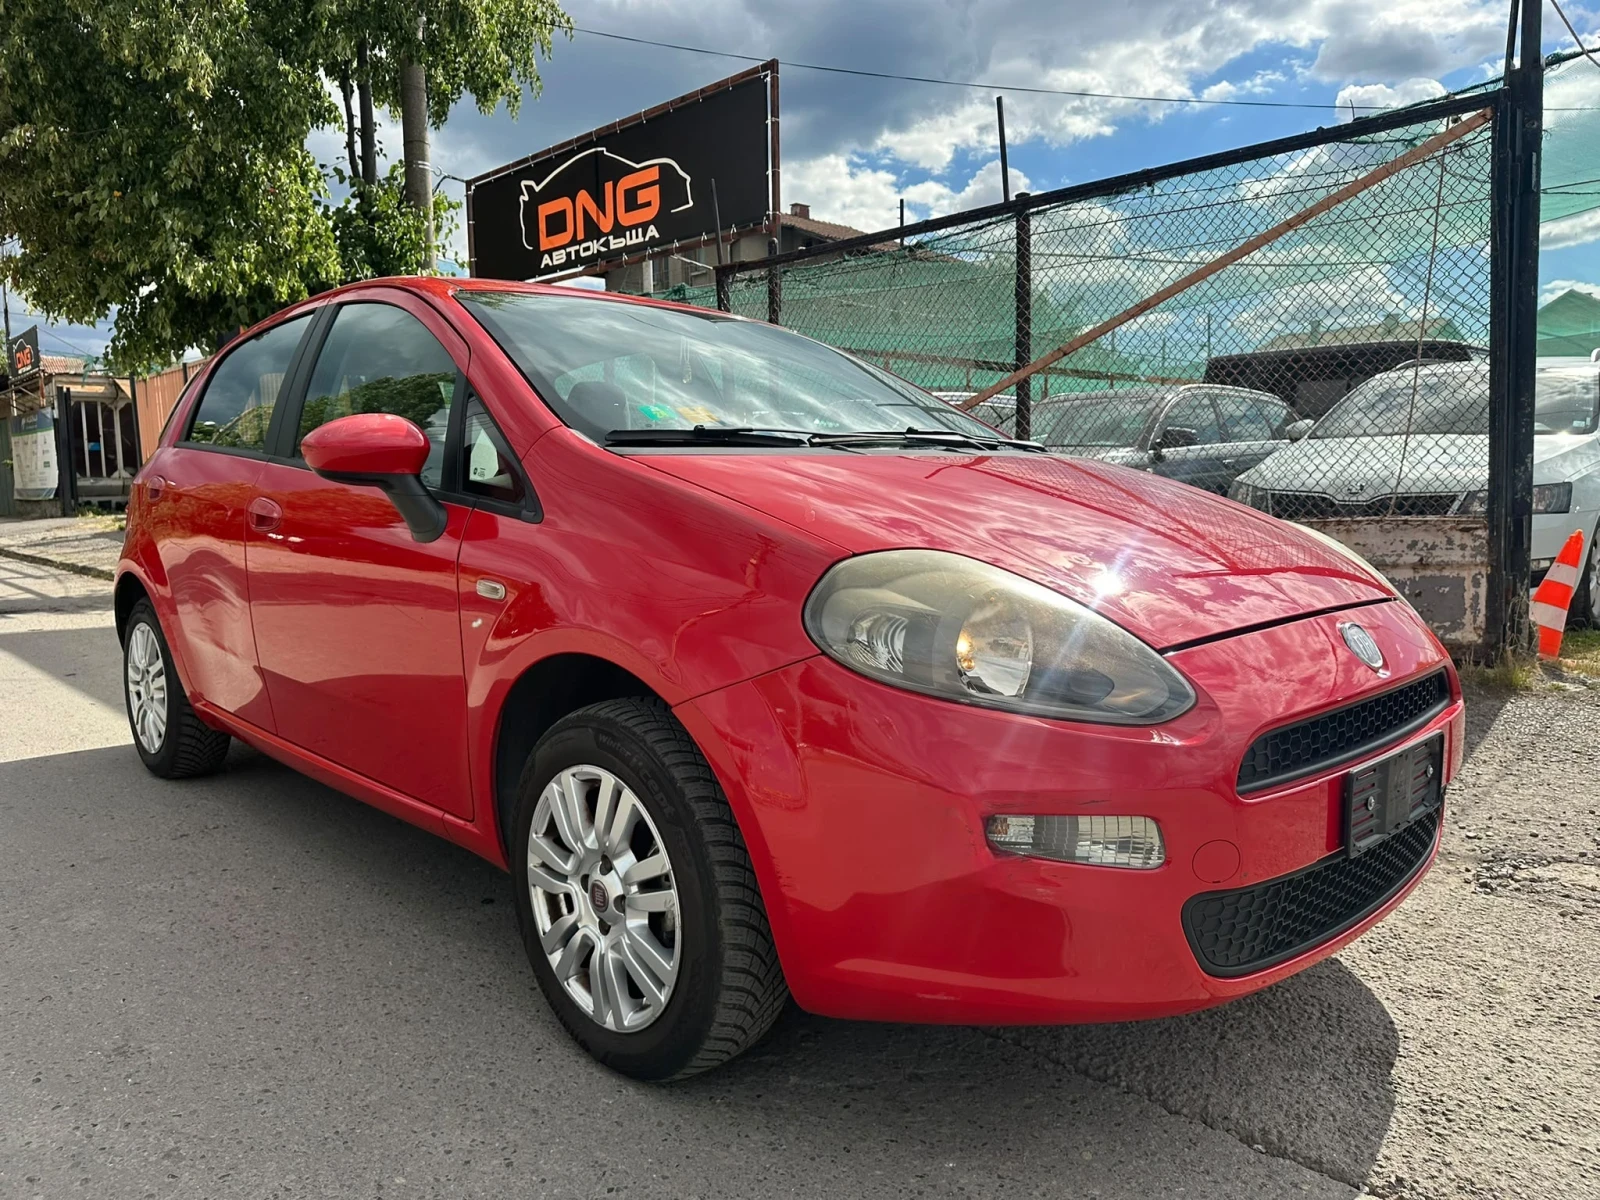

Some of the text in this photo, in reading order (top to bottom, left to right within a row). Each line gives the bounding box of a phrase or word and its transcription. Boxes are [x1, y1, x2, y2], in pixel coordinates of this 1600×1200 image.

[538, 165, 660, 251] DNG
[540, 224, 660, 269] АВТОКЪЩА
[15, 347, 32, 369] DNG
[594, 886, 604, 907] FIAT
